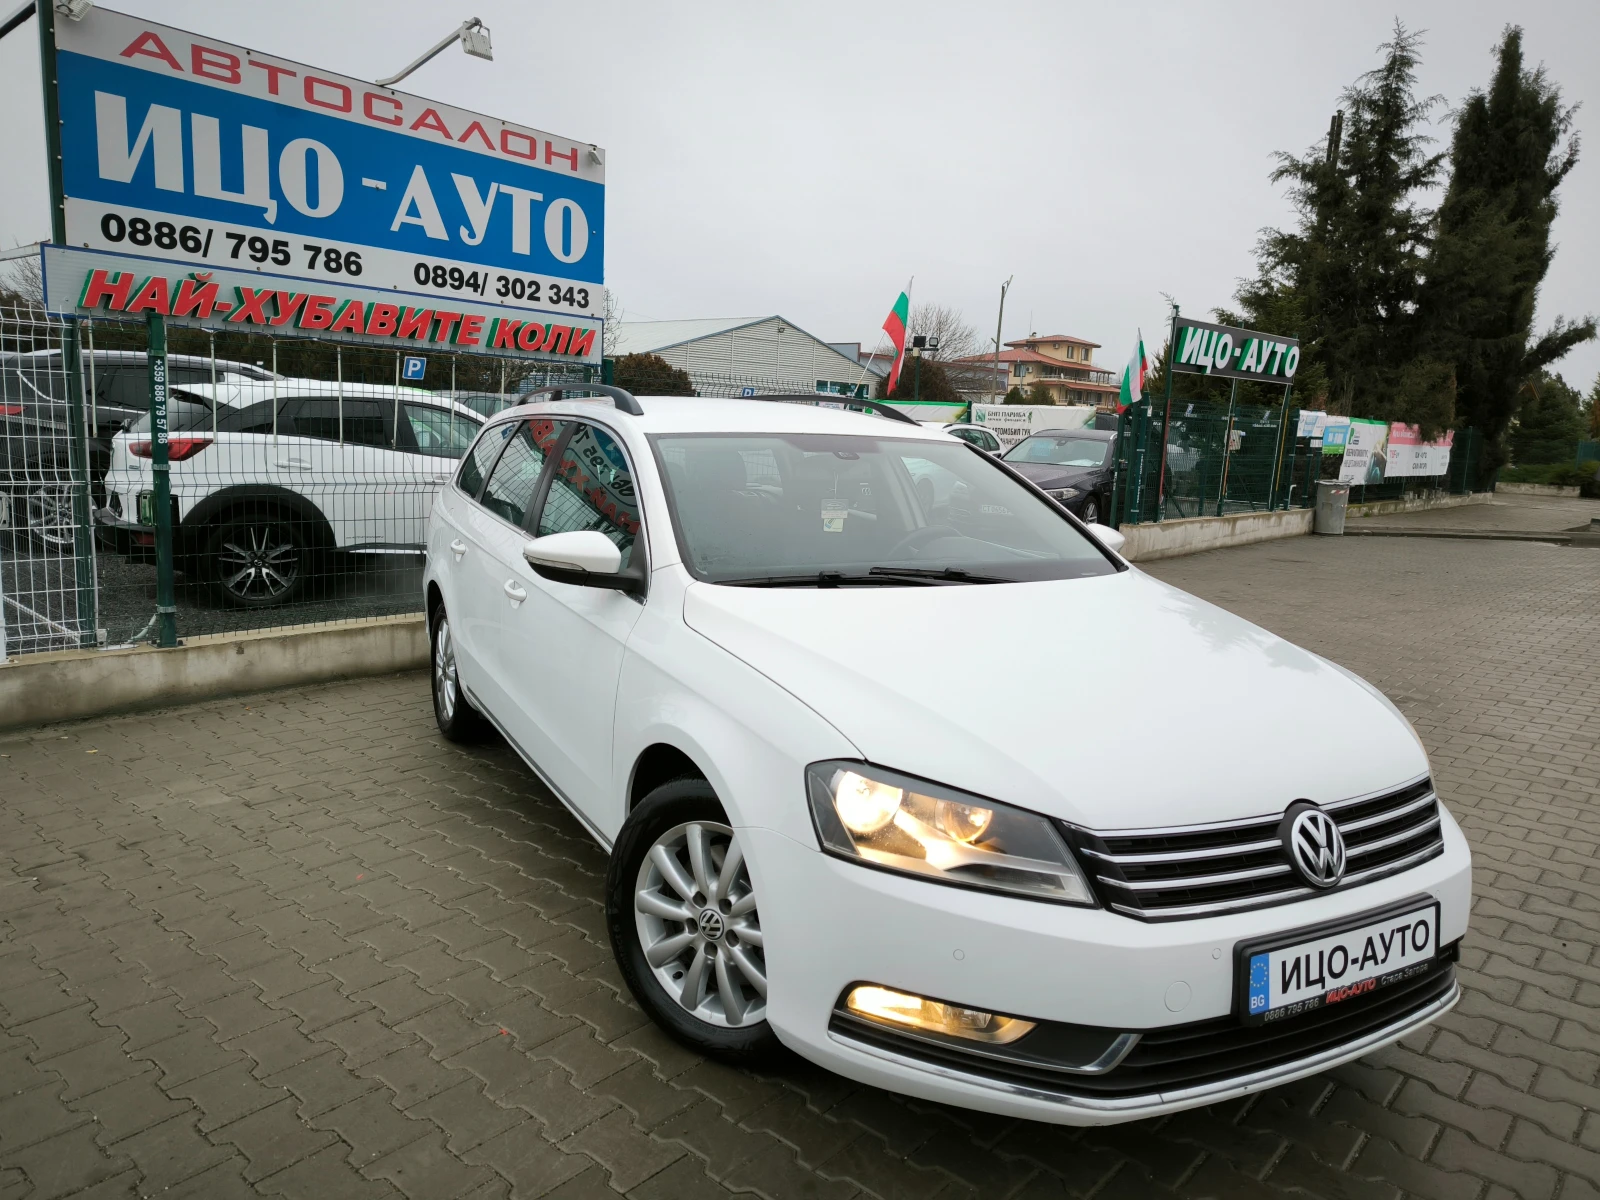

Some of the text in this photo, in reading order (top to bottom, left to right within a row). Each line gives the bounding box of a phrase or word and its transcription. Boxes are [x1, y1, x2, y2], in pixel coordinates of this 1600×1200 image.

[120, 31, 579, 172] АВТОСАЛОН
[100, 212, 363, 277] 0886/ 795 786
[78, 268, 596, 357] НАЙ-ХУБАВИТЕ КОЛИ
[413, 262, 590, 309] 0894/ 302 343
[1178, 326, 1300, 378] ИЦО-АУТО
[154, 358, 168, 444] +359 886 79 57 86
[1281, 919, 1430, 995] ИЦО-АУТО
[1250, 994, 1265, 1009] BG
[1264, 963, 1429, 1021] 0886 795 786 ИЦО-АУТО Стара Загора
